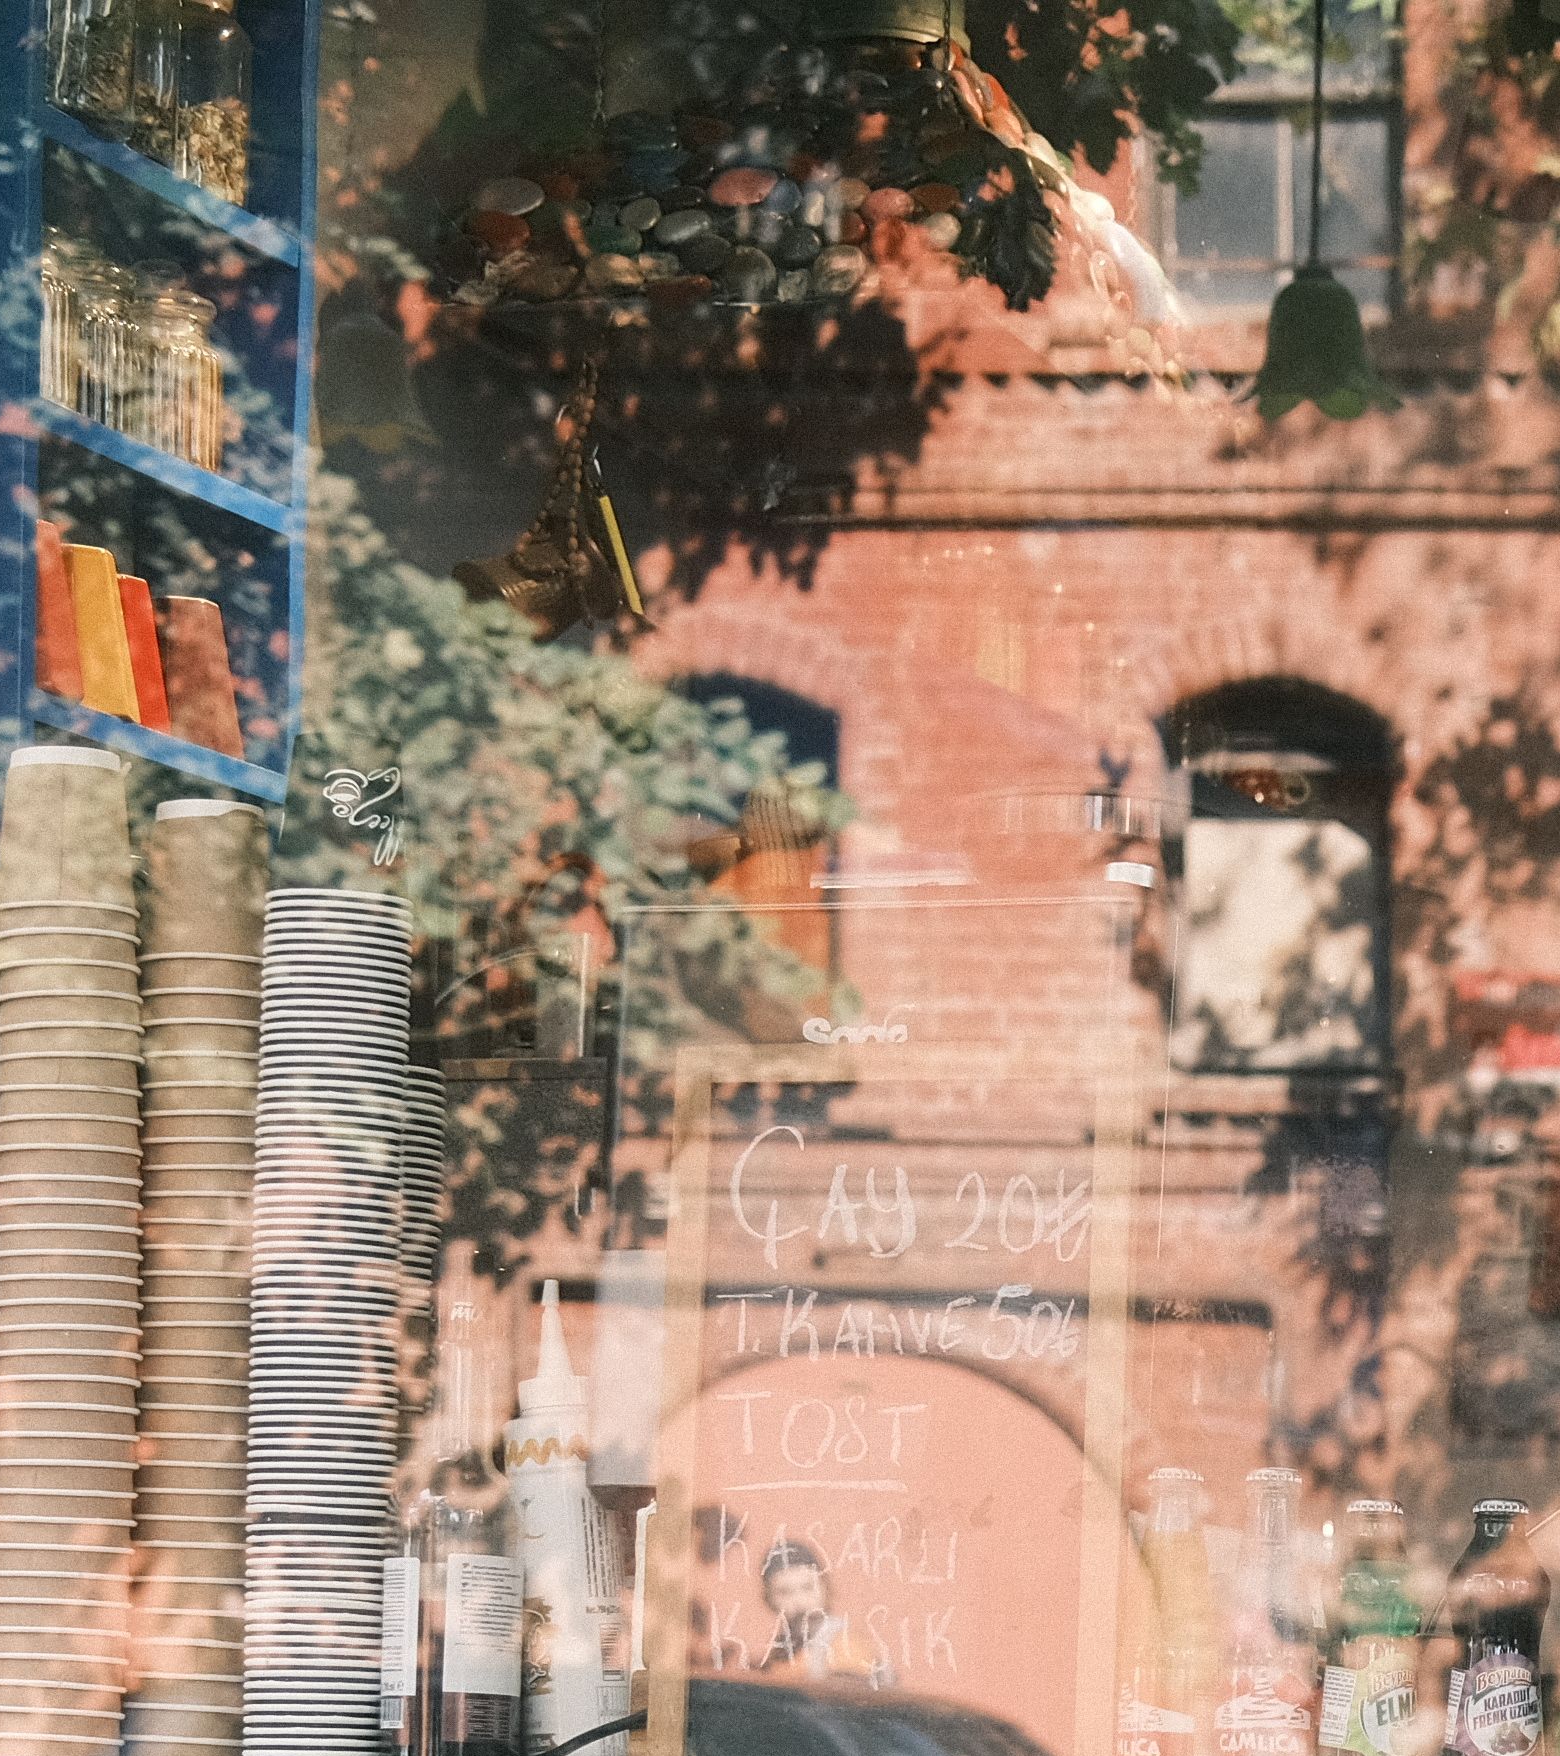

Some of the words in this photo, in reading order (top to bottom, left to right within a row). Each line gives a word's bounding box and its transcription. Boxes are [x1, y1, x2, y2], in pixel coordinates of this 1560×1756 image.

[729, 1125, 917, 1270] ÇAY
[715, 1391, 929, 1469] TOST
[1473, 1709, 1508, 1730] FRENK
